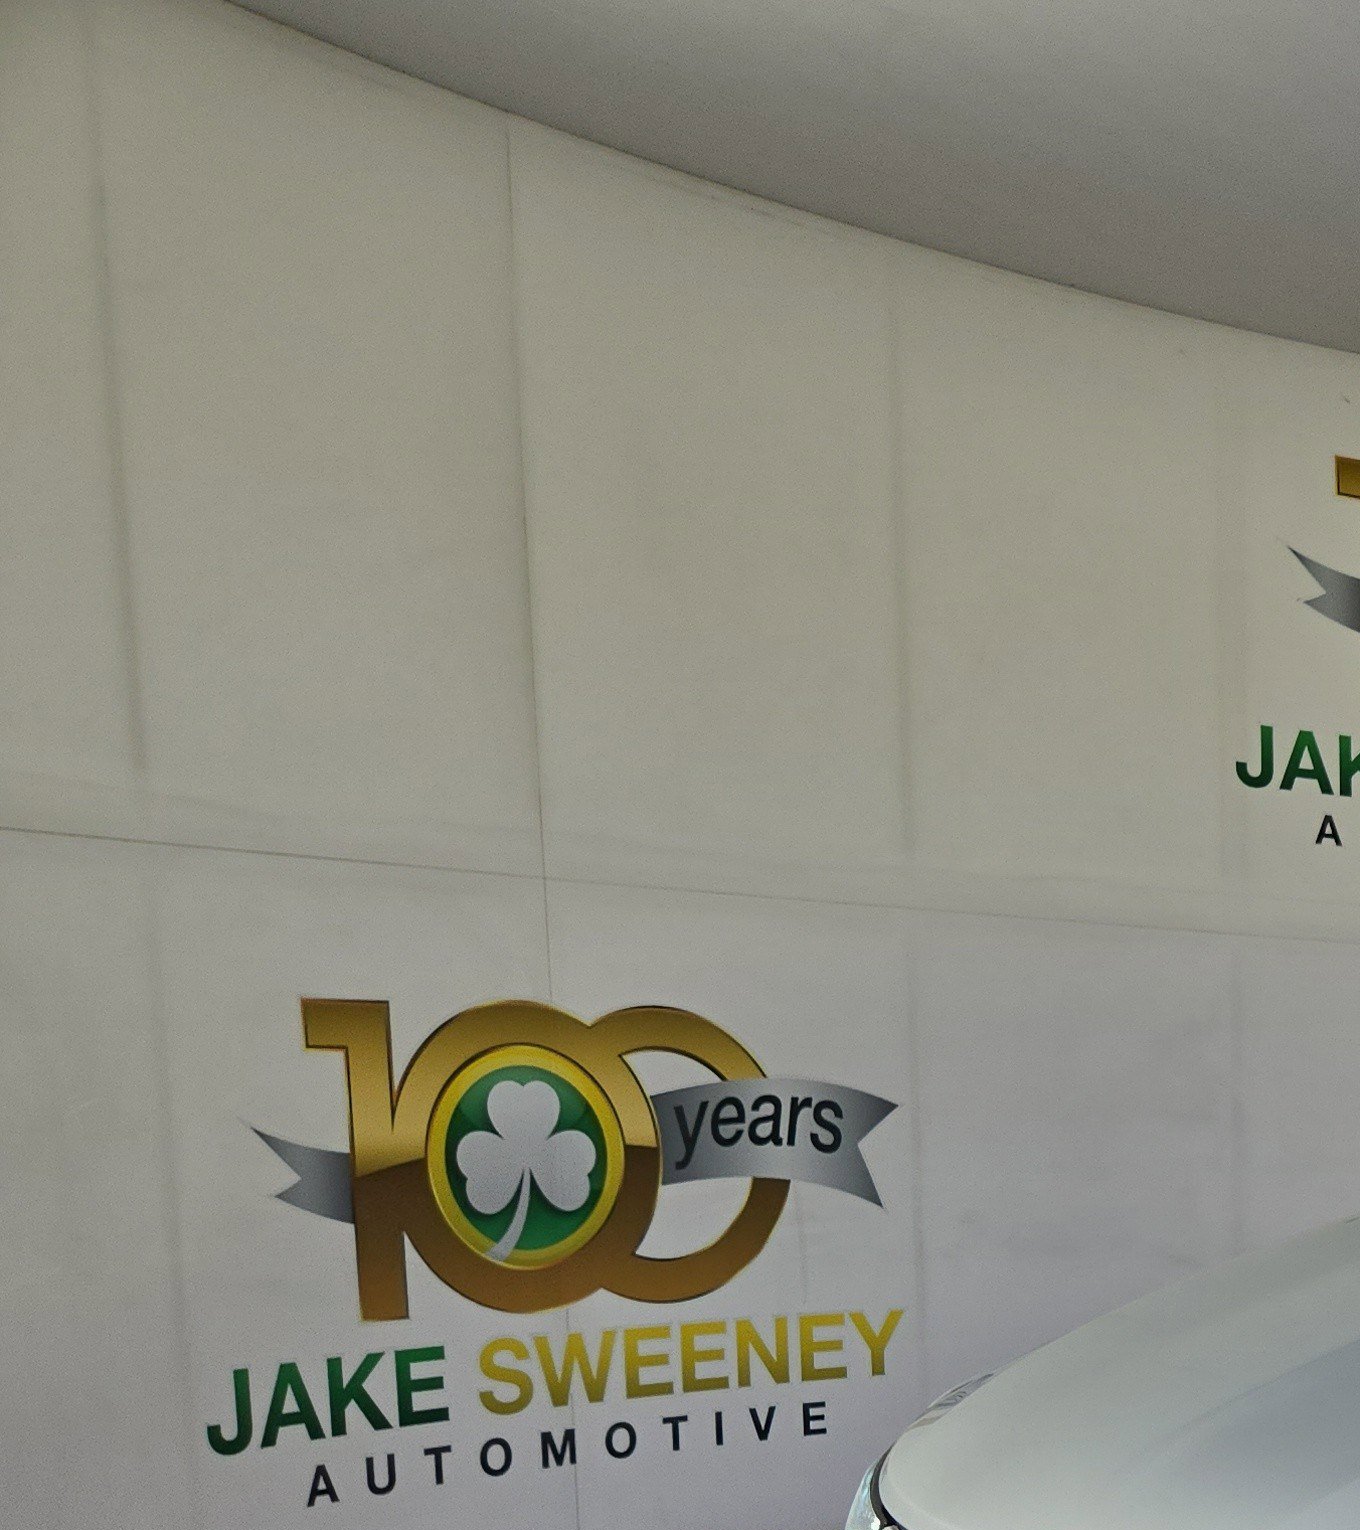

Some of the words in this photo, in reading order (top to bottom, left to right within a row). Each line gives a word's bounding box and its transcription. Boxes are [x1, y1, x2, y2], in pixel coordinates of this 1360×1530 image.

[673, 1093, 844, 1172] years
[206, 1345, 451, 1457] JAKE
[477, 1308, 905, 1417] SWEENEY
[306, 1400, 828, 1508] AUTOMOTIVE
